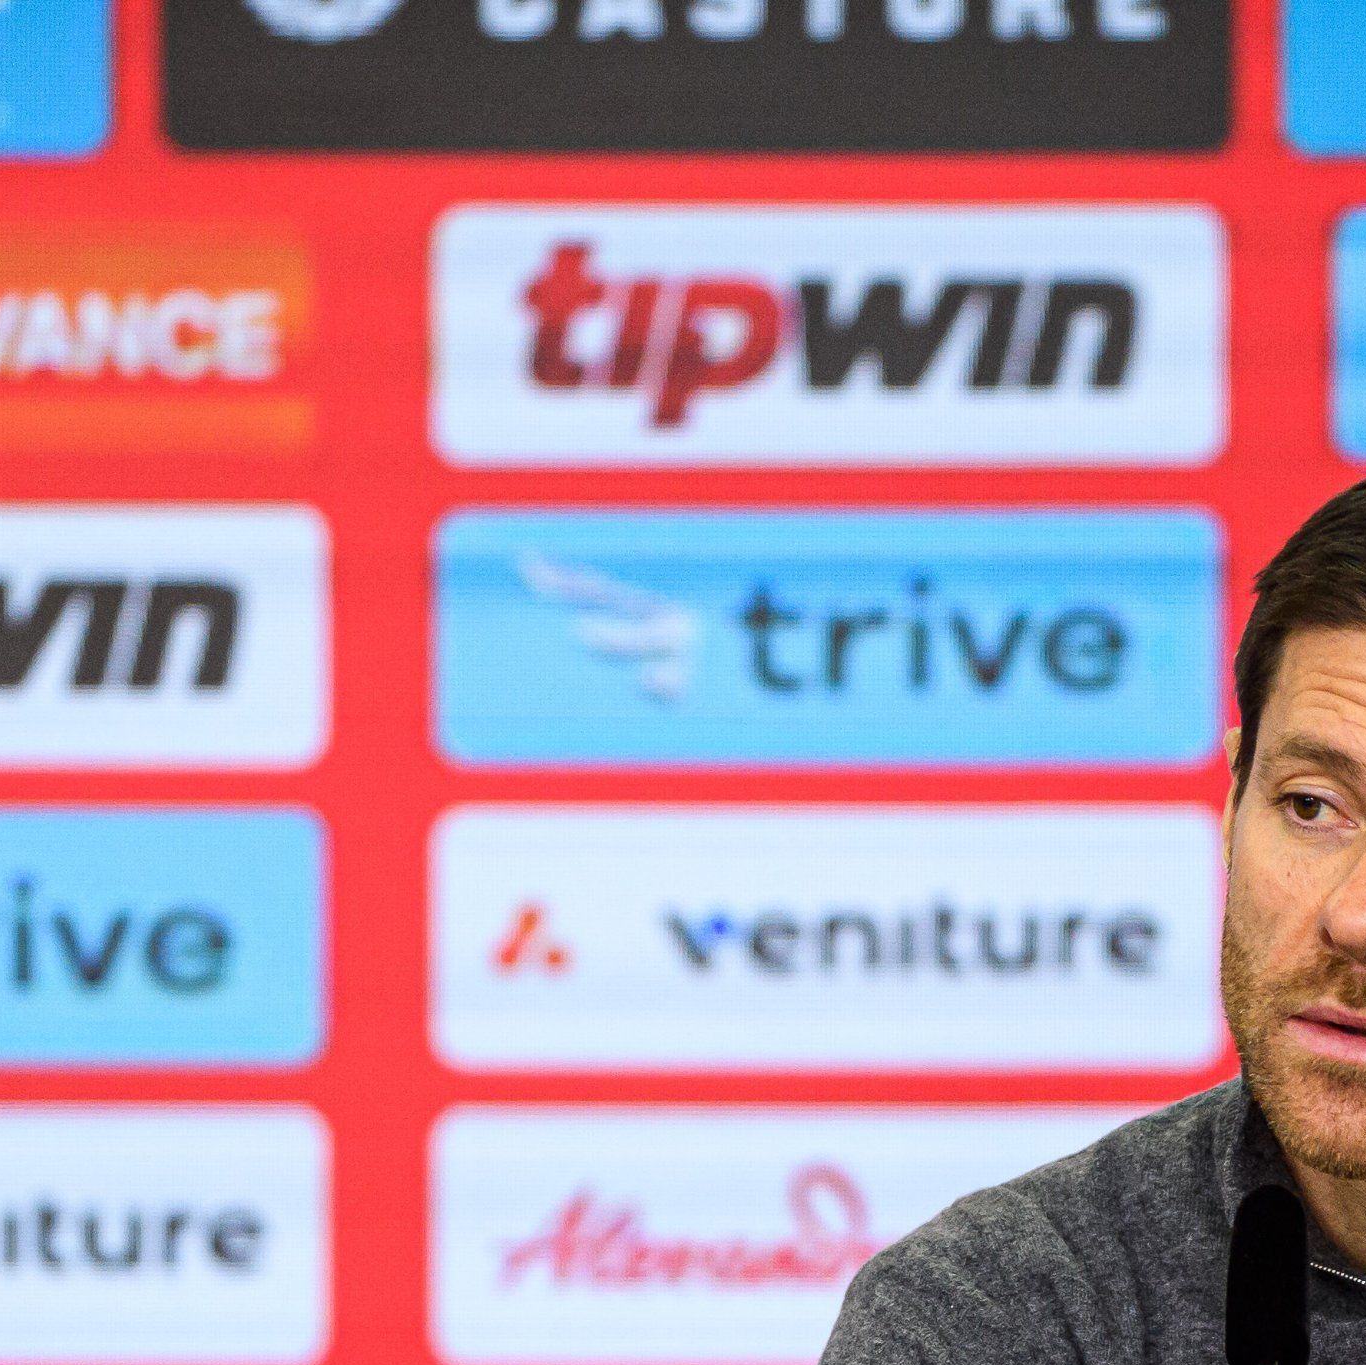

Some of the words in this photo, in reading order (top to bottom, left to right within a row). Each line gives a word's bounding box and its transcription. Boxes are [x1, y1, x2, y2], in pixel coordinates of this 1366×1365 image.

[523, 240, 1141, 428] tipwin
[742, 570, 1127, 691] trive
[663, 889, 1160, 972] veniture
